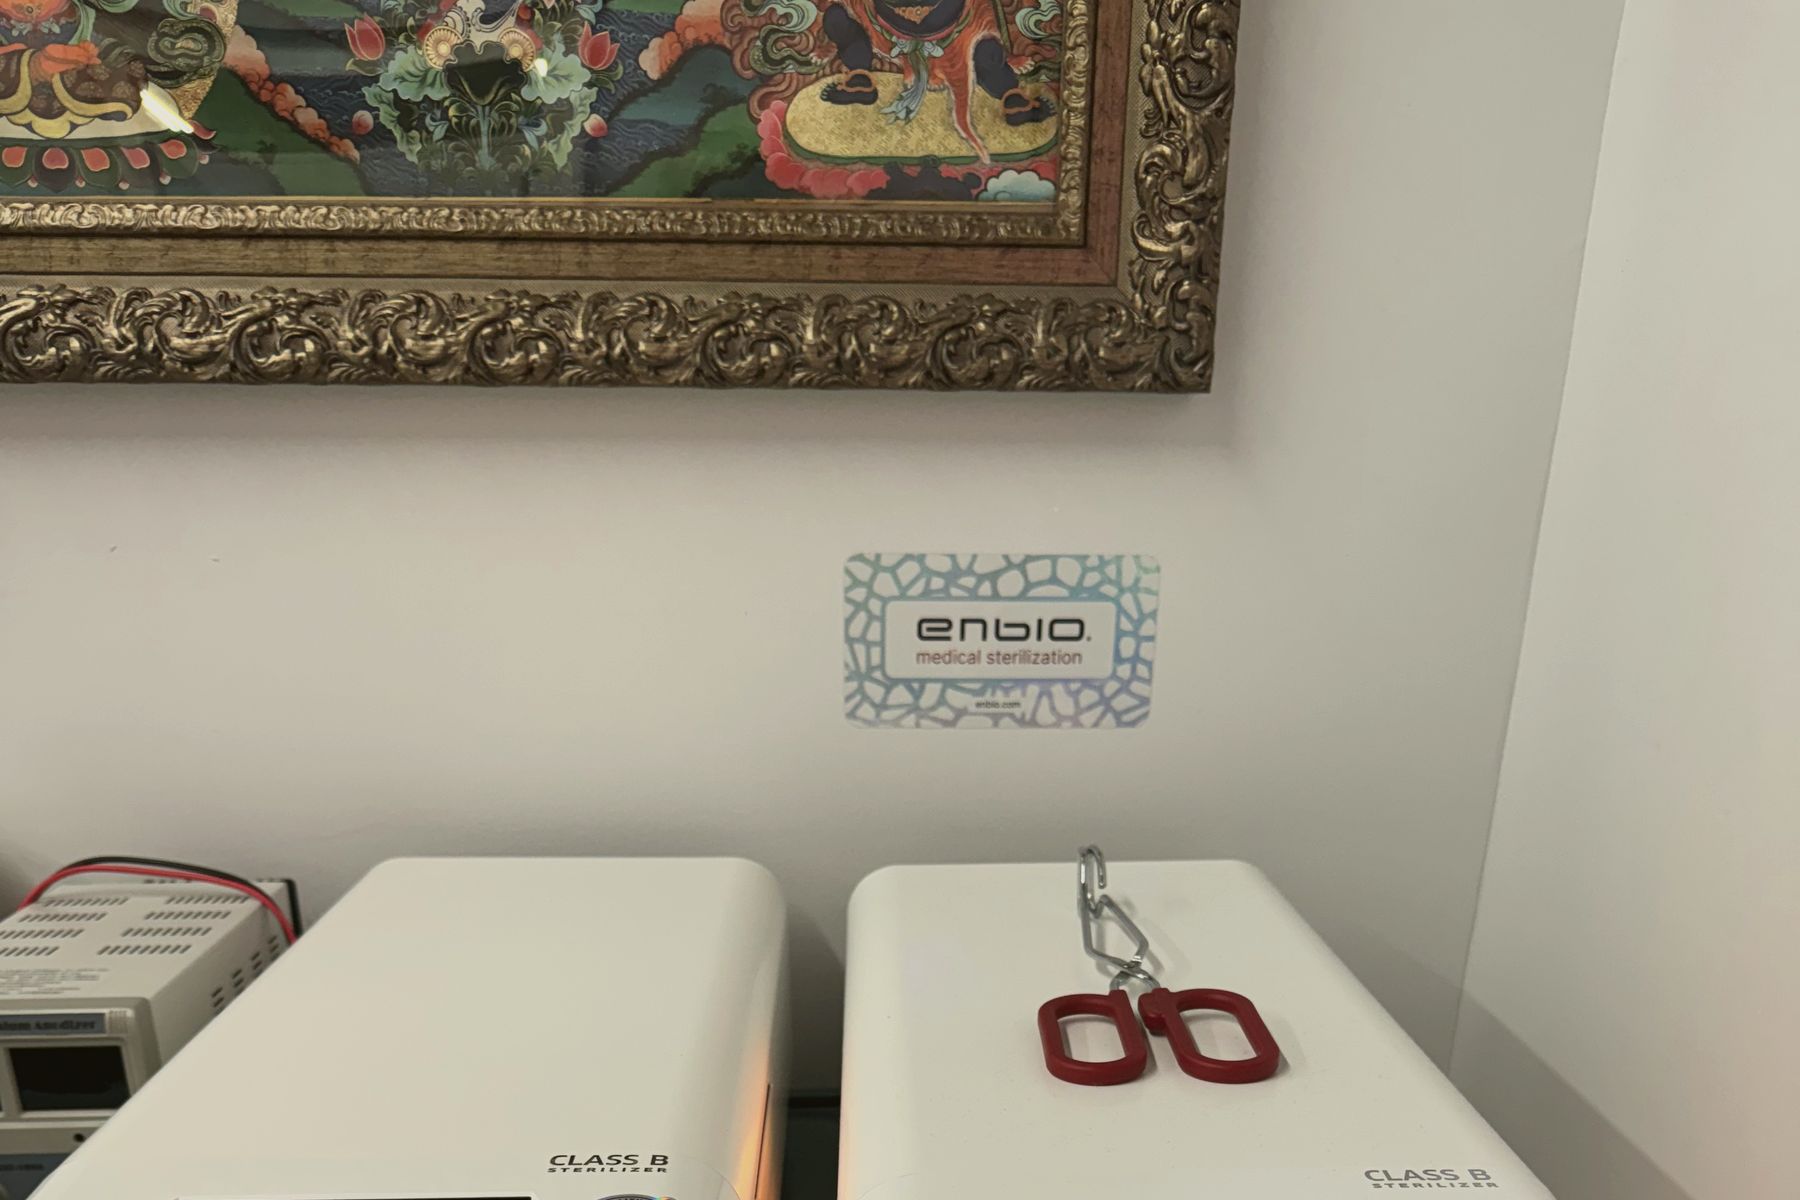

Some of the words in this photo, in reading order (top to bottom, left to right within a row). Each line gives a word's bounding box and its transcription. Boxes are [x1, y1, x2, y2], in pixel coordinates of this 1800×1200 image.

[916, 650, 981, 665] medical
[986, 650, 1082, 665] sterilization
[550, 1154, 639, 1166] CLASS
[650, 1154, 669, 1166] B
[1364, 1169, 1460, 1182] CLASS
[1468, 1169, 1492, 1181] B
